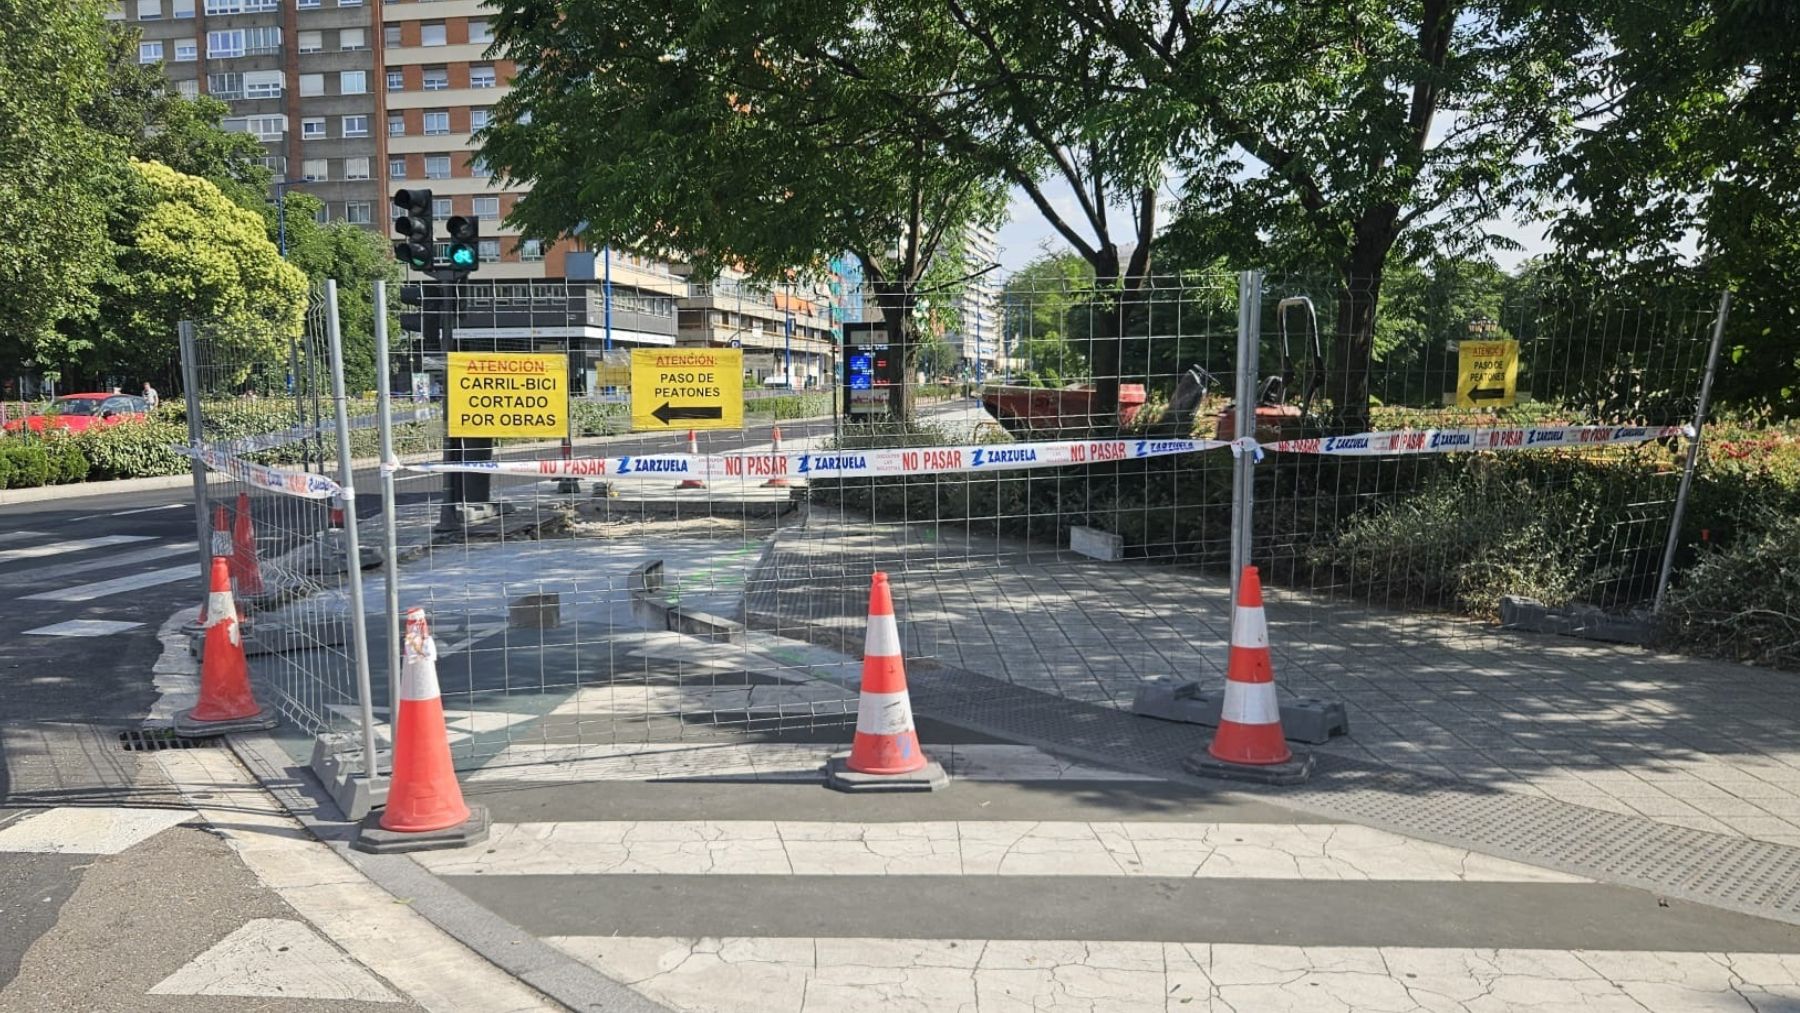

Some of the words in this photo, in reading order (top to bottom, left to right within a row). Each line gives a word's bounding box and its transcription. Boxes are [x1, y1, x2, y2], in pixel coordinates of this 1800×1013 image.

[1473, 360, 1493, 369] PASO
[1494, 360, 1503, 369] DE
[460, 377, 556, 391] CARRIL-BICI
[660, 373, 694, 383] PASO
[698, 373, 715, 383] DE
[1470, 372, 1505, 382] PEATONES
[655, 387, 720, 398] PEATONES
[468, 395, 548, 408] CORTADO
[461, 413, 495, 427] POR
[500, 414, 556, 427] OBRAS
[1389, 434, 1400, 450] NO
[1402, 432, 1427, 450] PASAR
[1441, 434, 1470, 446] ZARZUELA
[1489, 431, 1500, 447] NO
[1500, 430, 1524, 446] PASAR
[1536, 430, 1564, 442] ZARZUELA
[1336, 438, 1369, 449] ZARZUELA
[988, 449, 1036, 463] ZARZUELA
[1071, 445, 1085, 462] NO
[1090, 442, 1127, 461] PASAR
[539, 459, 557, 474] NO
[563, 458, 605, 475] PASAR
[634, 459, 688, 472] ZARZUELA
[725, 456, 742, 476] NO
[747, 455, 787, 476] PASAR
[815, 456, 866, 471] ZARZUELA
[902, 452, 918, 471] NO
[924, 450, 962, 470] PASAR
